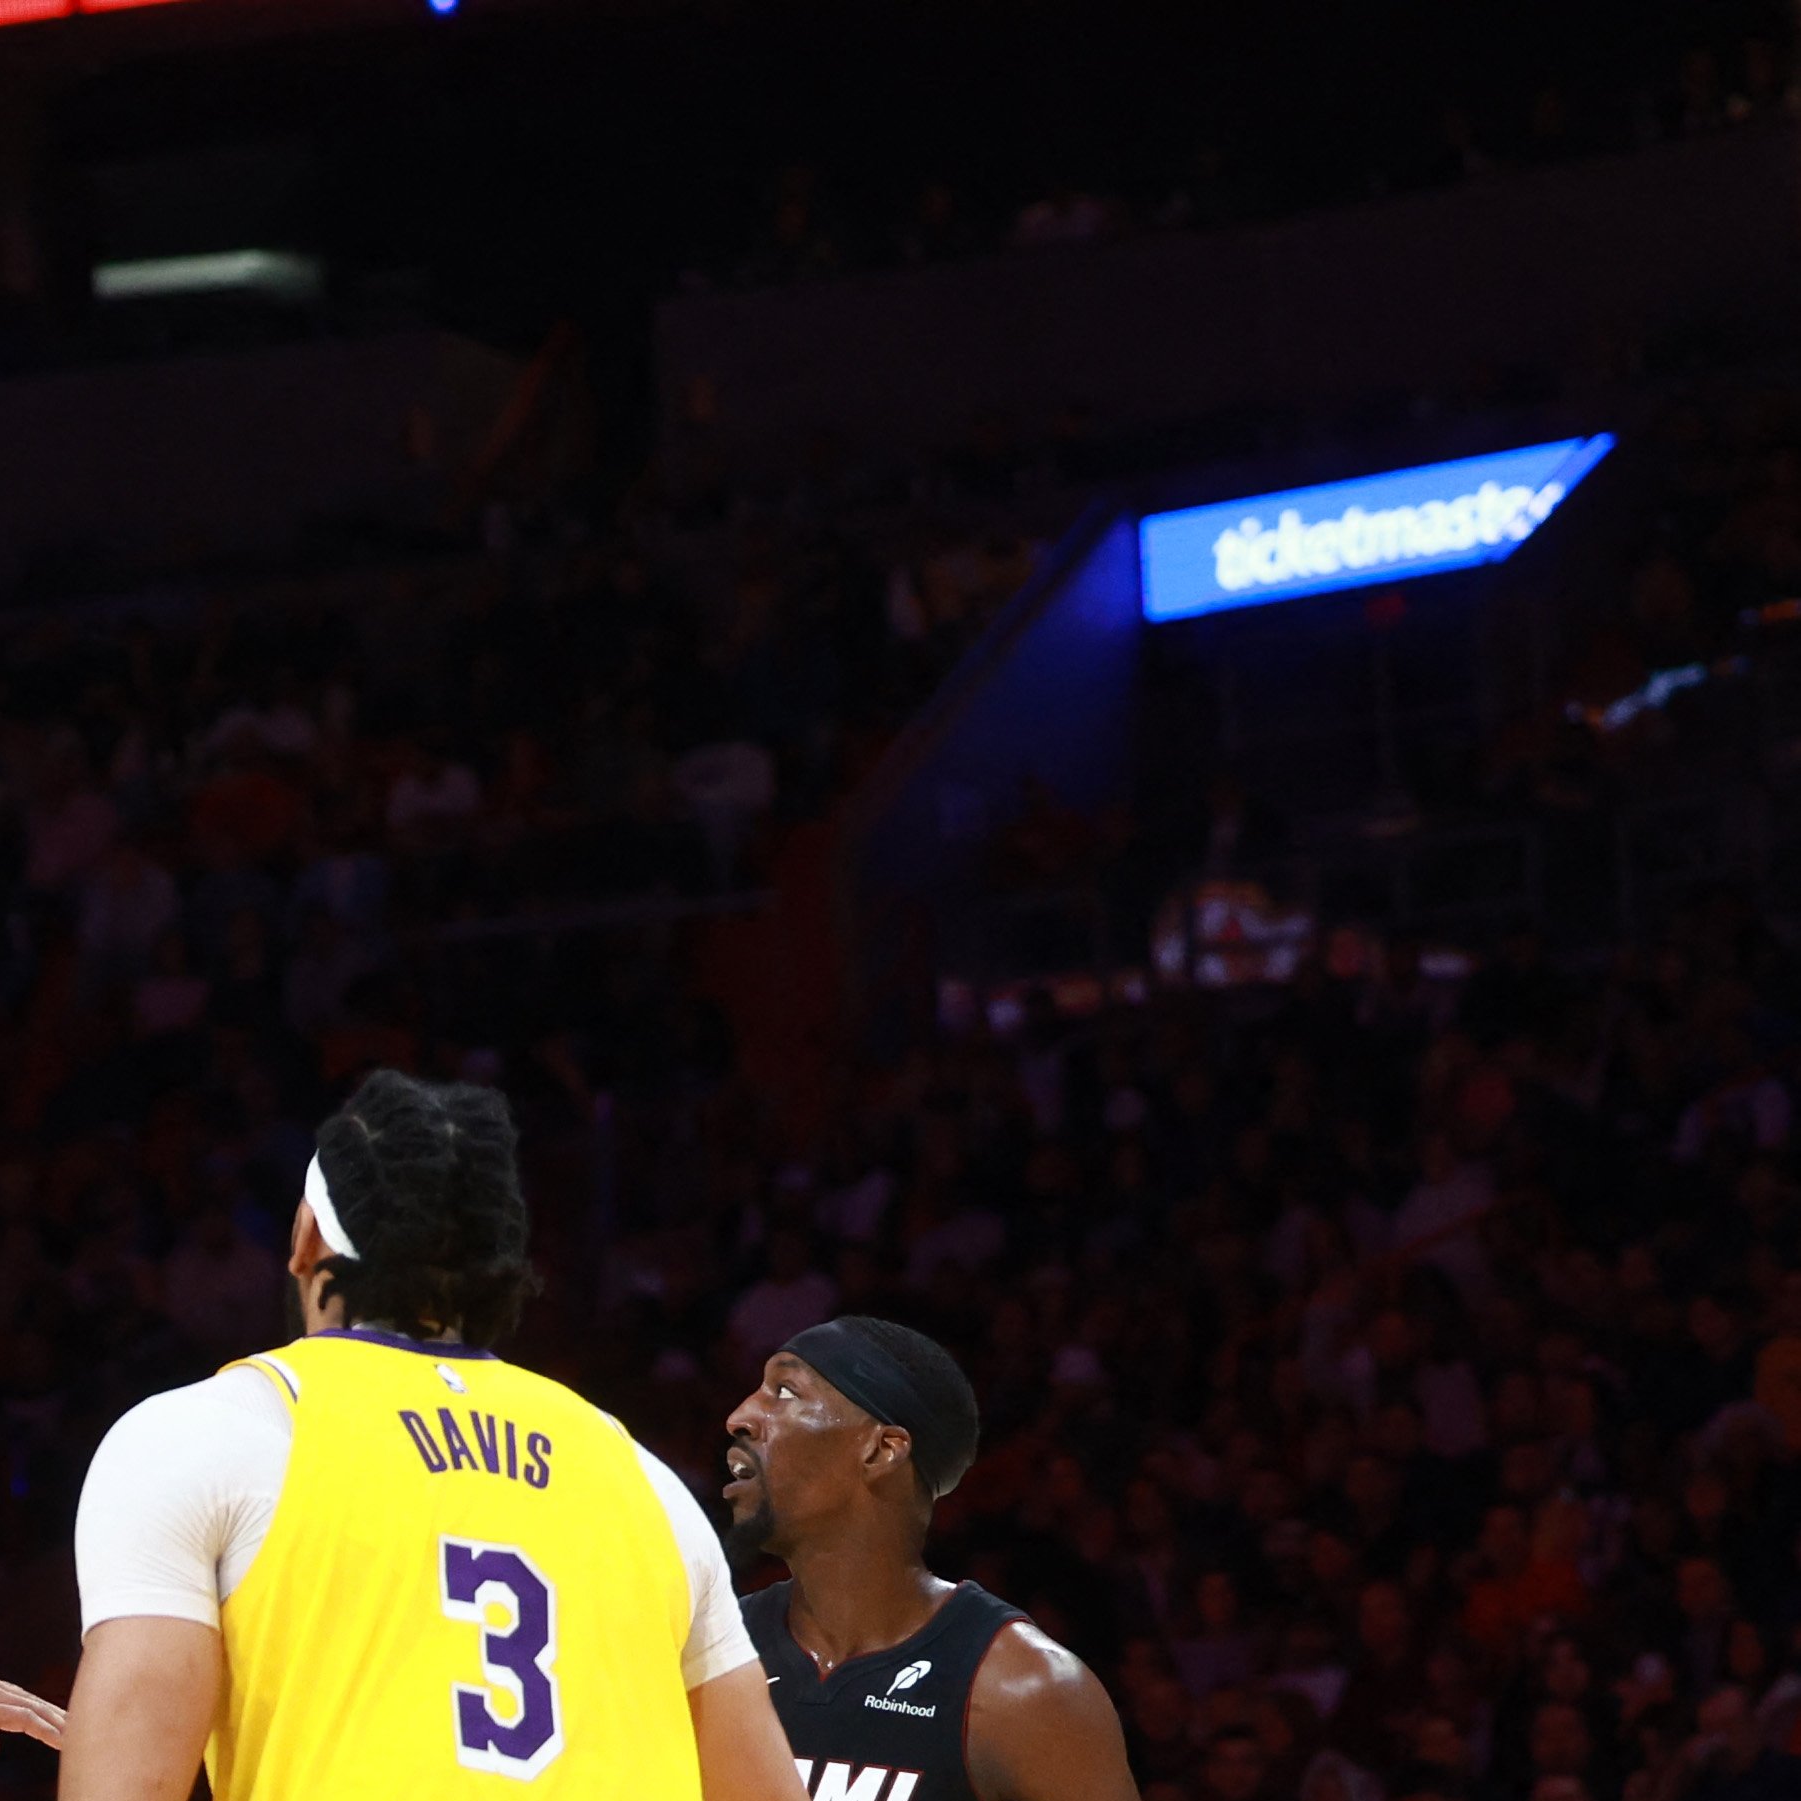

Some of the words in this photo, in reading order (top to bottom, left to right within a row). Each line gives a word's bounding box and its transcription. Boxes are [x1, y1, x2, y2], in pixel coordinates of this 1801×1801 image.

[398, 1406, 553, 1490] DAVIS
[437, 1532, 565, 1783] 3
[864, 1694, 937, 1719] Robinhood
